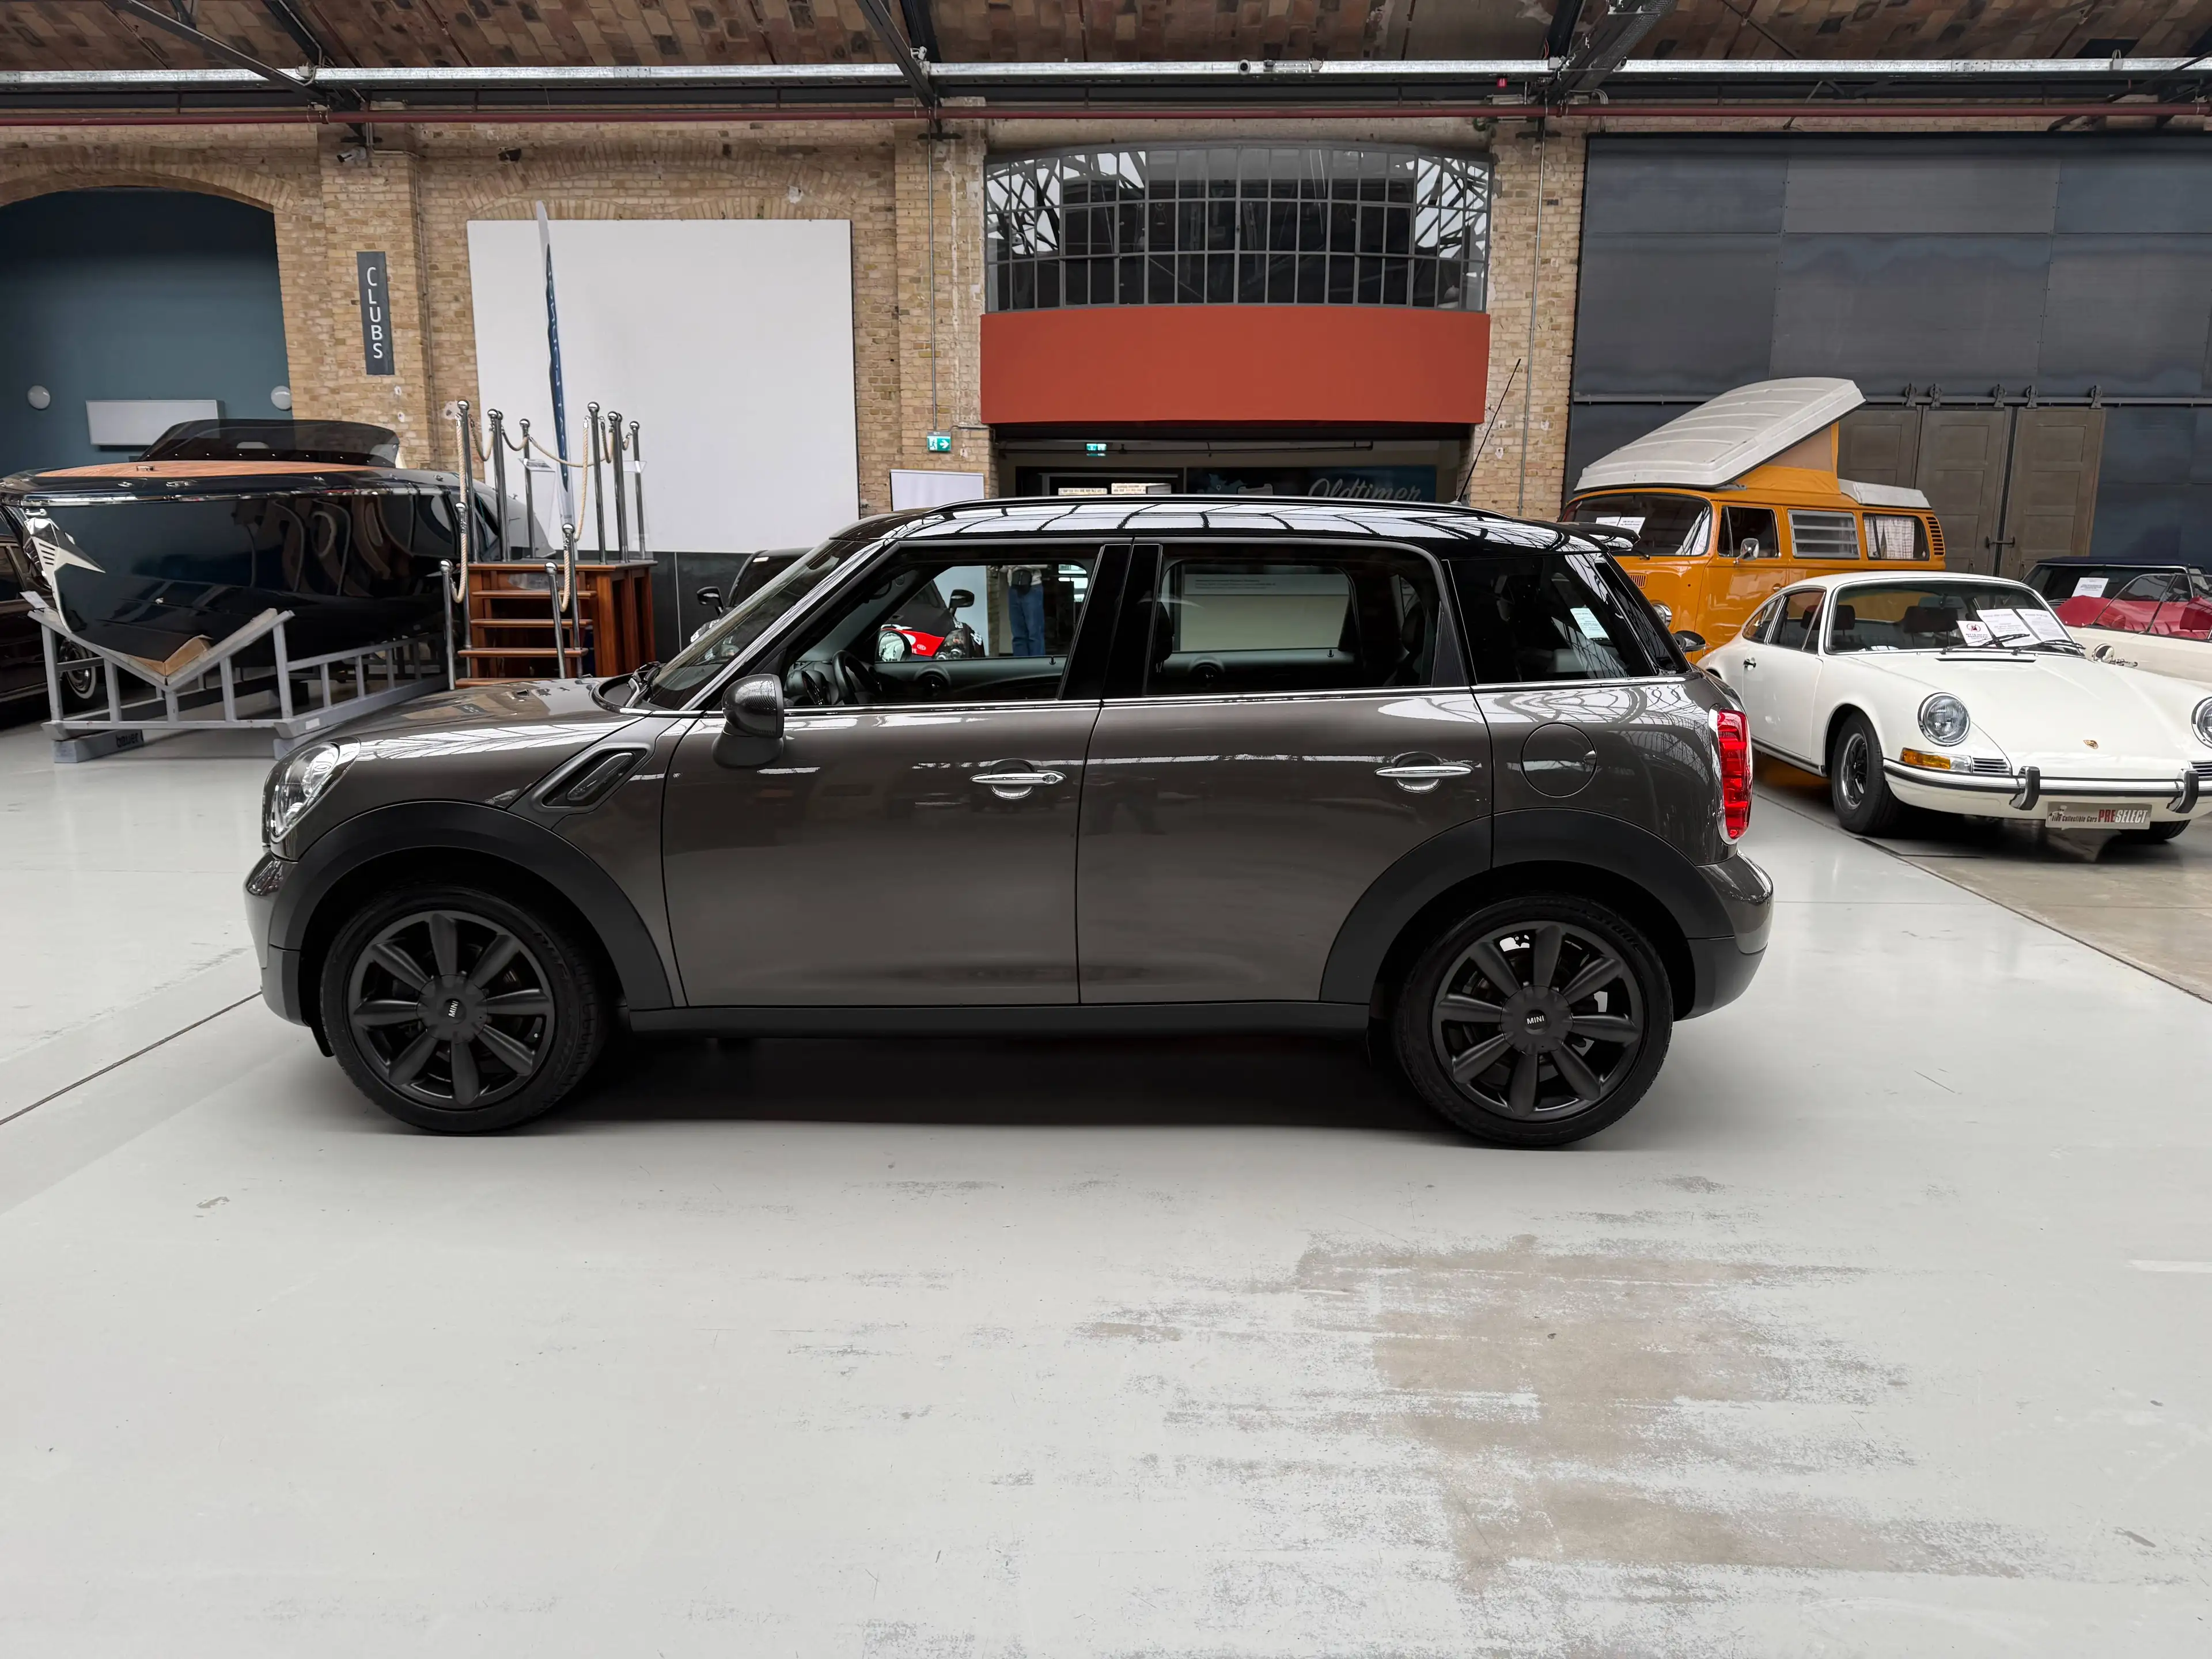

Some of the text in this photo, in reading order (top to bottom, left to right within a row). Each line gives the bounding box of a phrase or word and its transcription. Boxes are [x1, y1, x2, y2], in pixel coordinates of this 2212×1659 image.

[367, 267, 383, 359] CLUBS
[1308, 478, 1421, 501] Oldtimer
[2098, 809, 2148, 824] PRESELECT
[448, 1001, 459, 1017] MINI
[1527, 1015, 1544, 1024] MINI
